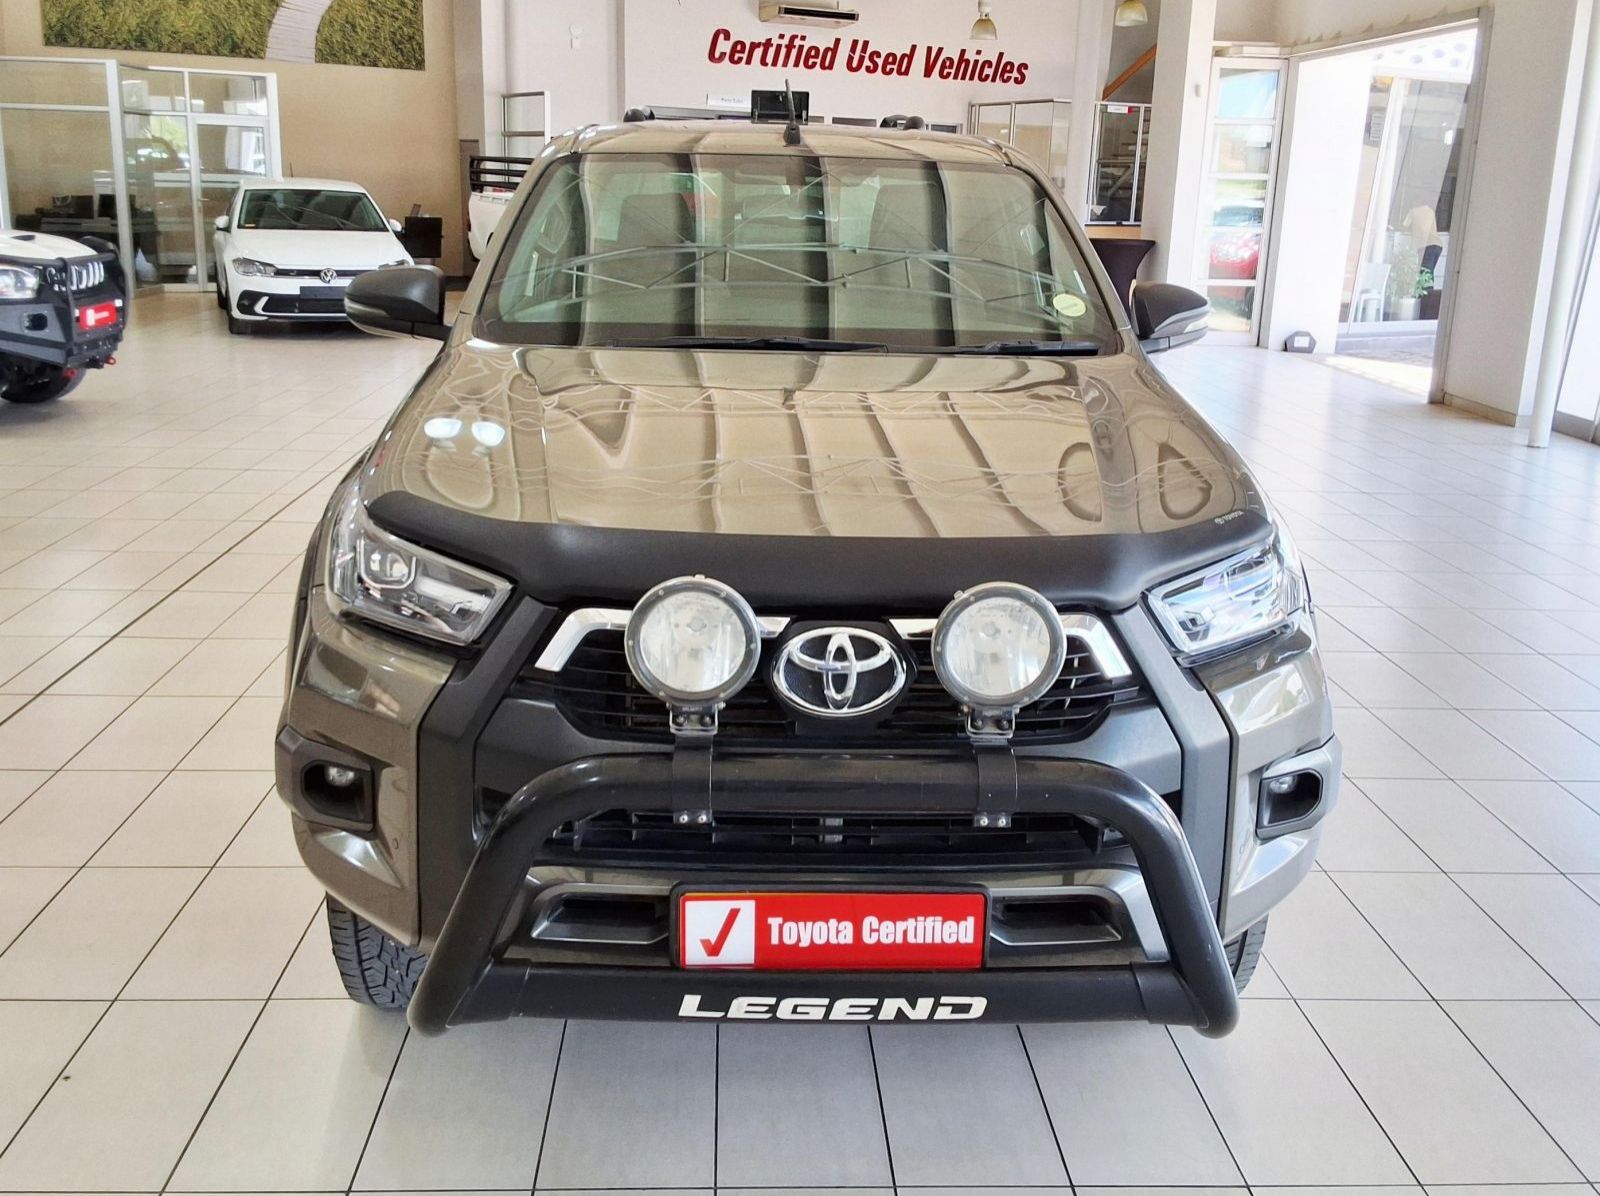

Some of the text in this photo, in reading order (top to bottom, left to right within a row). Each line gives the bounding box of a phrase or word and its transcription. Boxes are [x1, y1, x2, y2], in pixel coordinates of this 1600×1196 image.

[708, 28, 1029, 85] Certified Used Vehicles
[768, 916, 975, 947] Toyota Certified
[678, 994, 988, 1021] LEGEND
